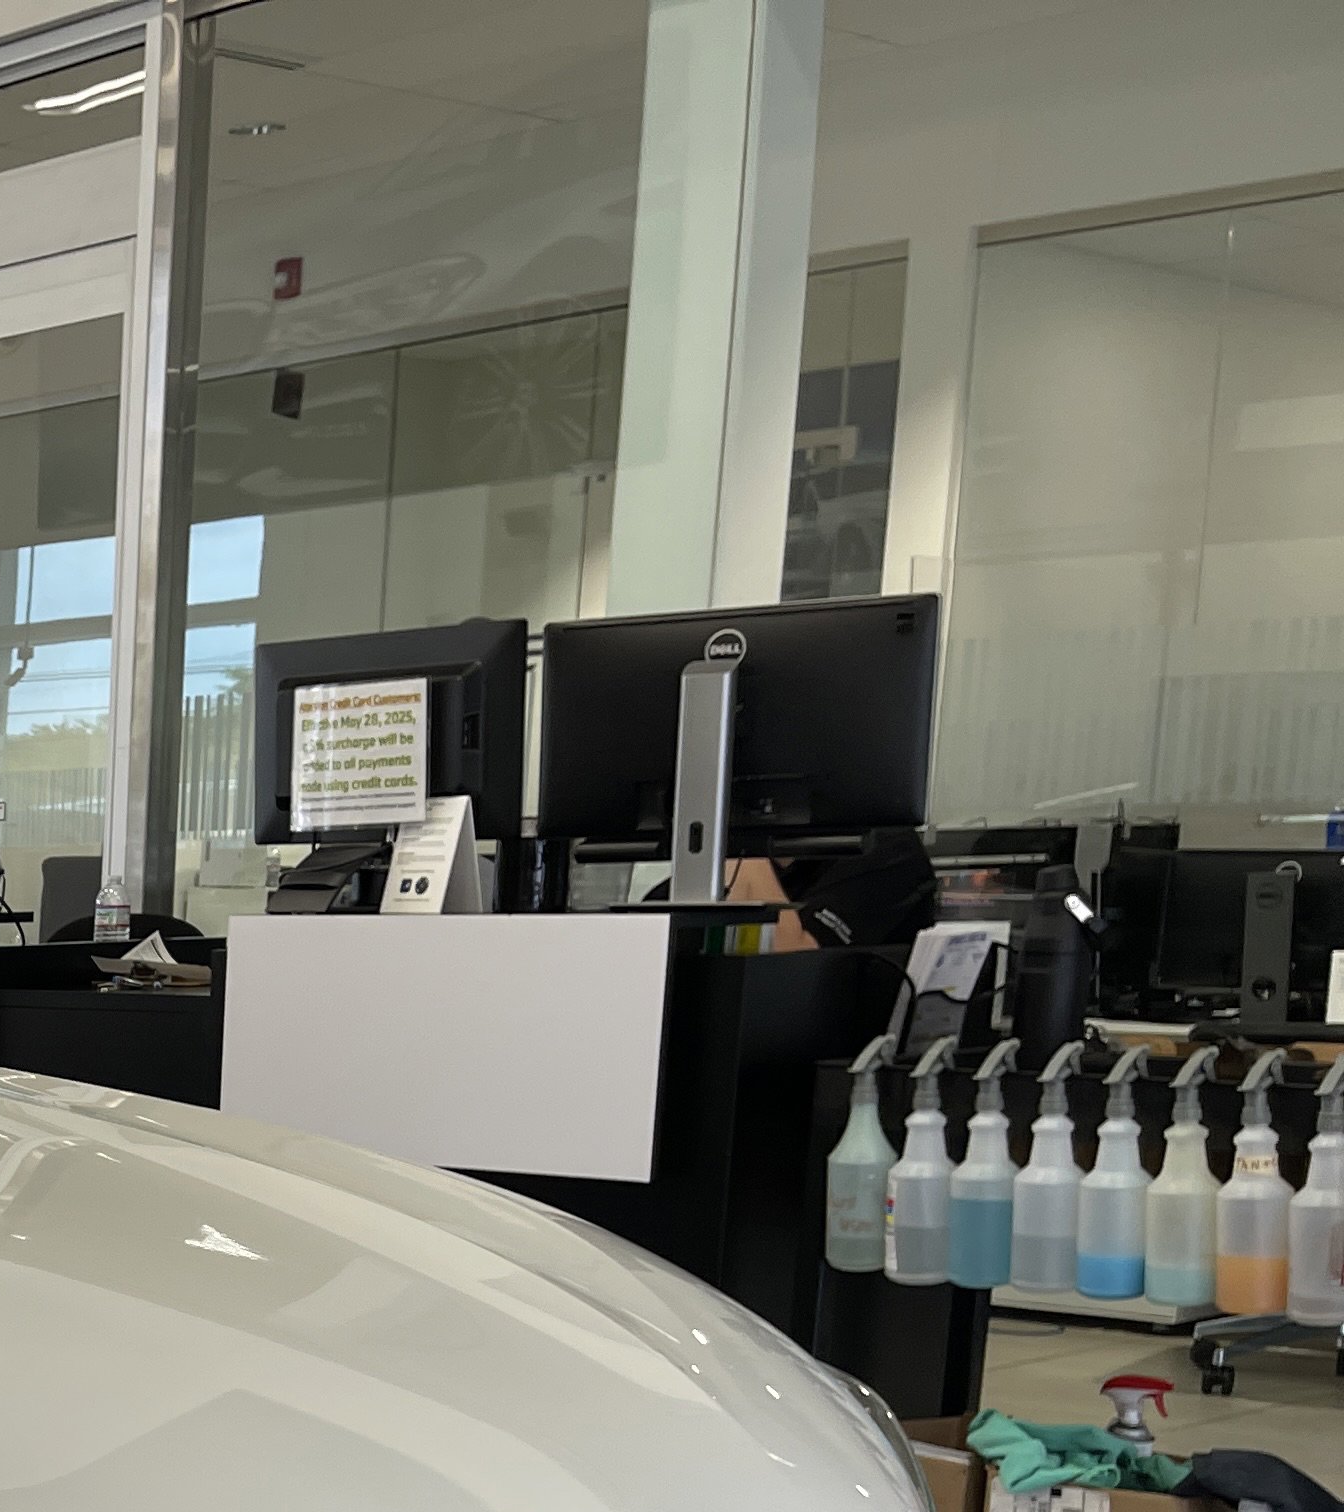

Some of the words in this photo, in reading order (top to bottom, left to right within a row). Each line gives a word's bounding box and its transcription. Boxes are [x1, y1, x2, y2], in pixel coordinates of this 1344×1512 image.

[341, 716, 362, 729] May
[384, 710, 416, 725] 2025,
[378, 734, 397, 746] will
[399, 733, 414, 745] be
[358, 755, 412, 770] payments
[352, 777, 382, 789] credit
